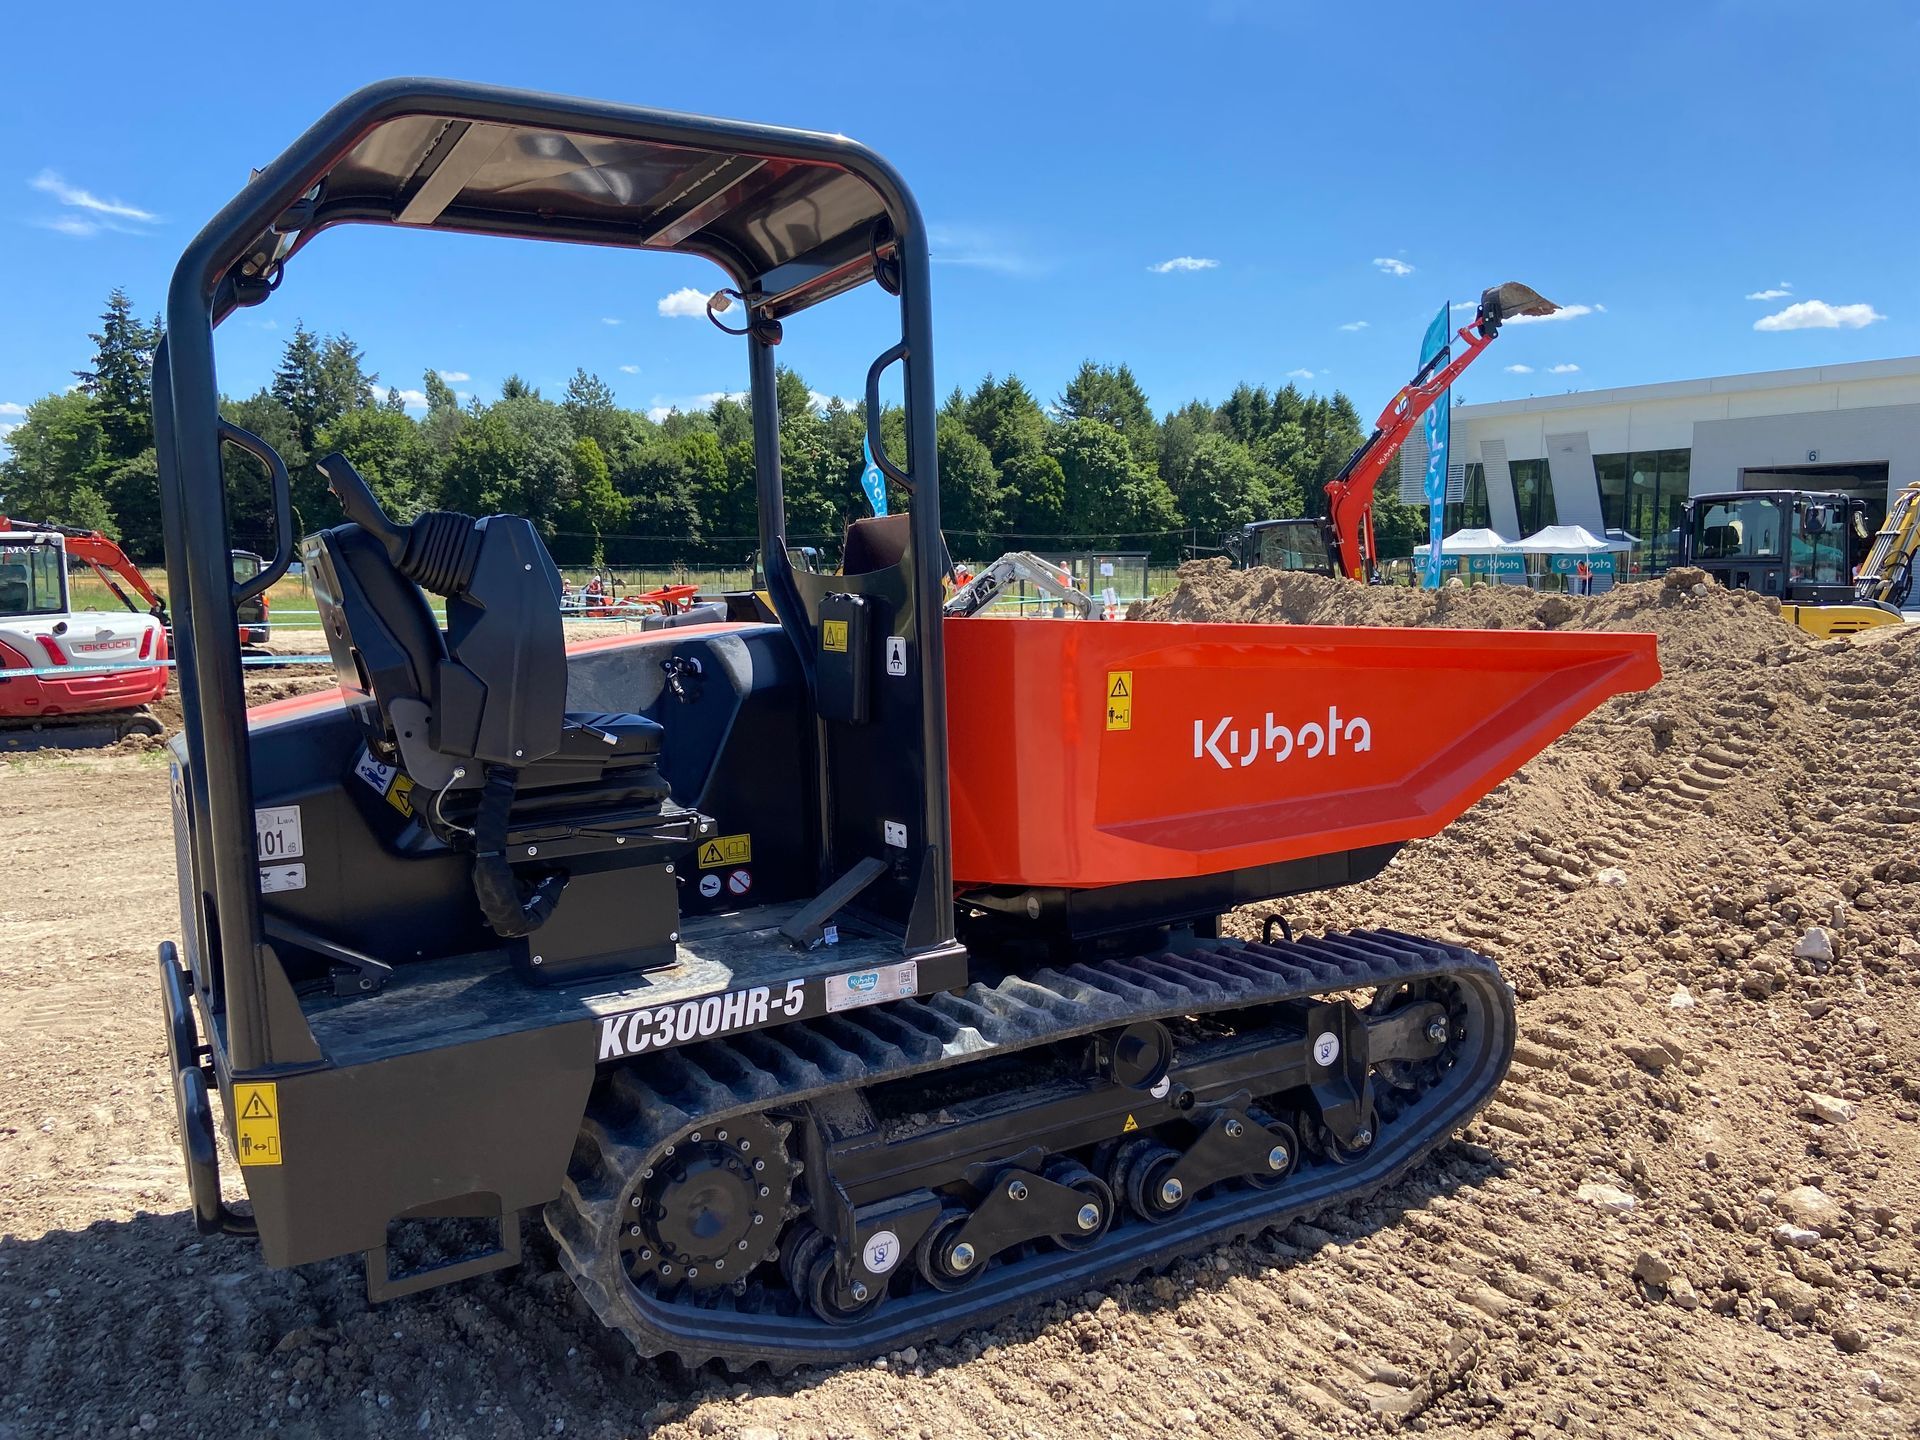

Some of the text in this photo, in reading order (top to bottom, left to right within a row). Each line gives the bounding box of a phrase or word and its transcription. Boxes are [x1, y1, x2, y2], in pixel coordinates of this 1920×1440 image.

[1377, 442, 1399, 465] Kubota
[1808, 450, 1817, 462] 6
[1573, 559, 1611, 569] Kbota
[1194, 705, 1371, 769] Kubota
[599, 978, 805, 1060] KC300HR-5
